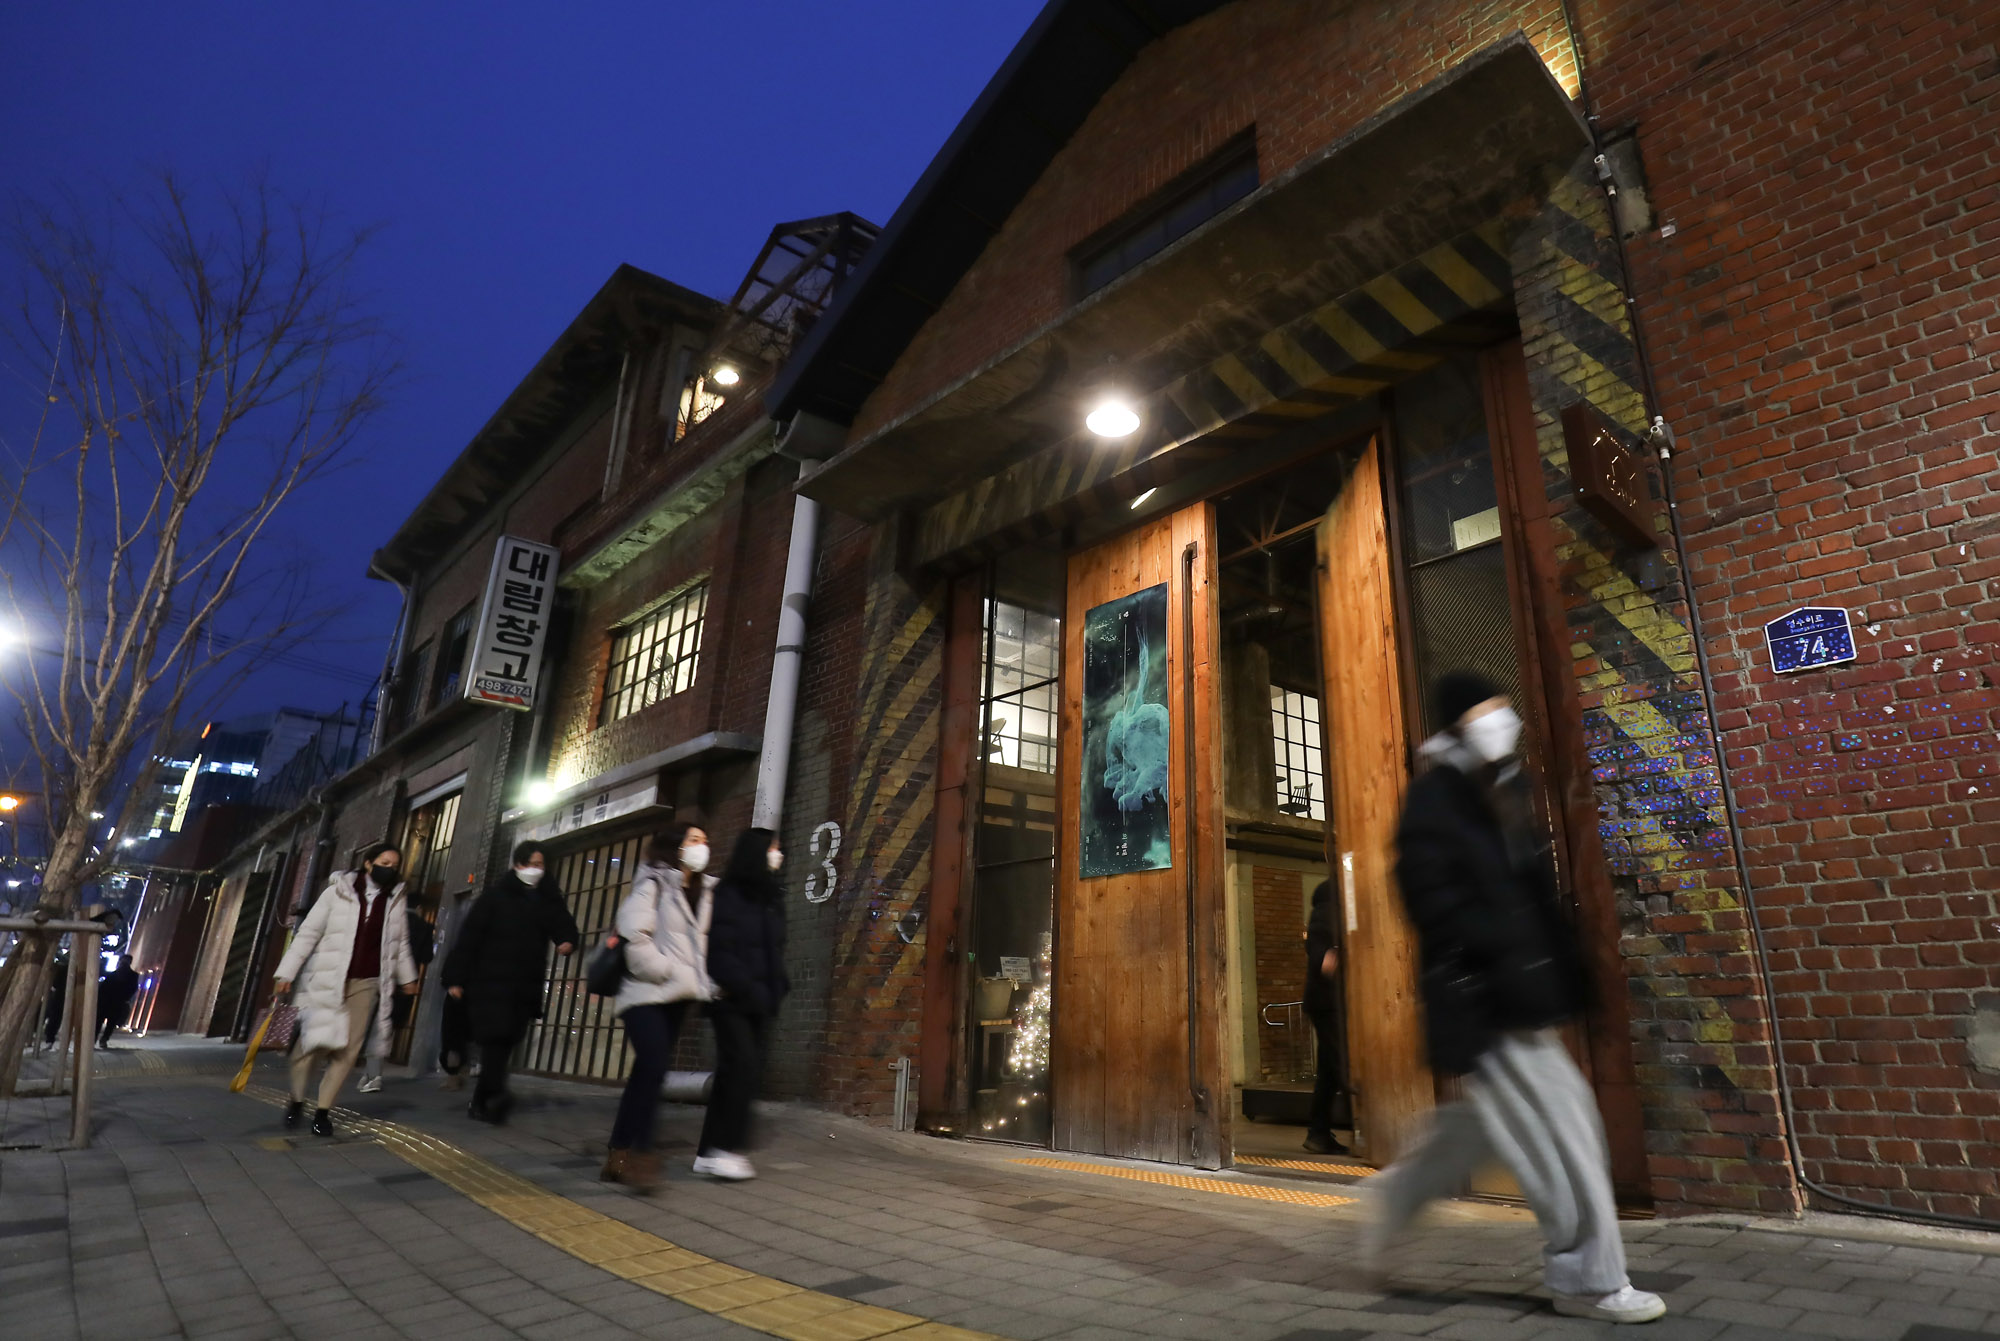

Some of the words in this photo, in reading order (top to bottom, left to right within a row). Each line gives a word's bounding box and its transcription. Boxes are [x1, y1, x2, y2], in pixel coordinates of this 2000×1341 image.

[485, 546, 550, 683] 대림창고
[1794, 635, 1826, 662] 74
[805, 821, 841, 903] 3
